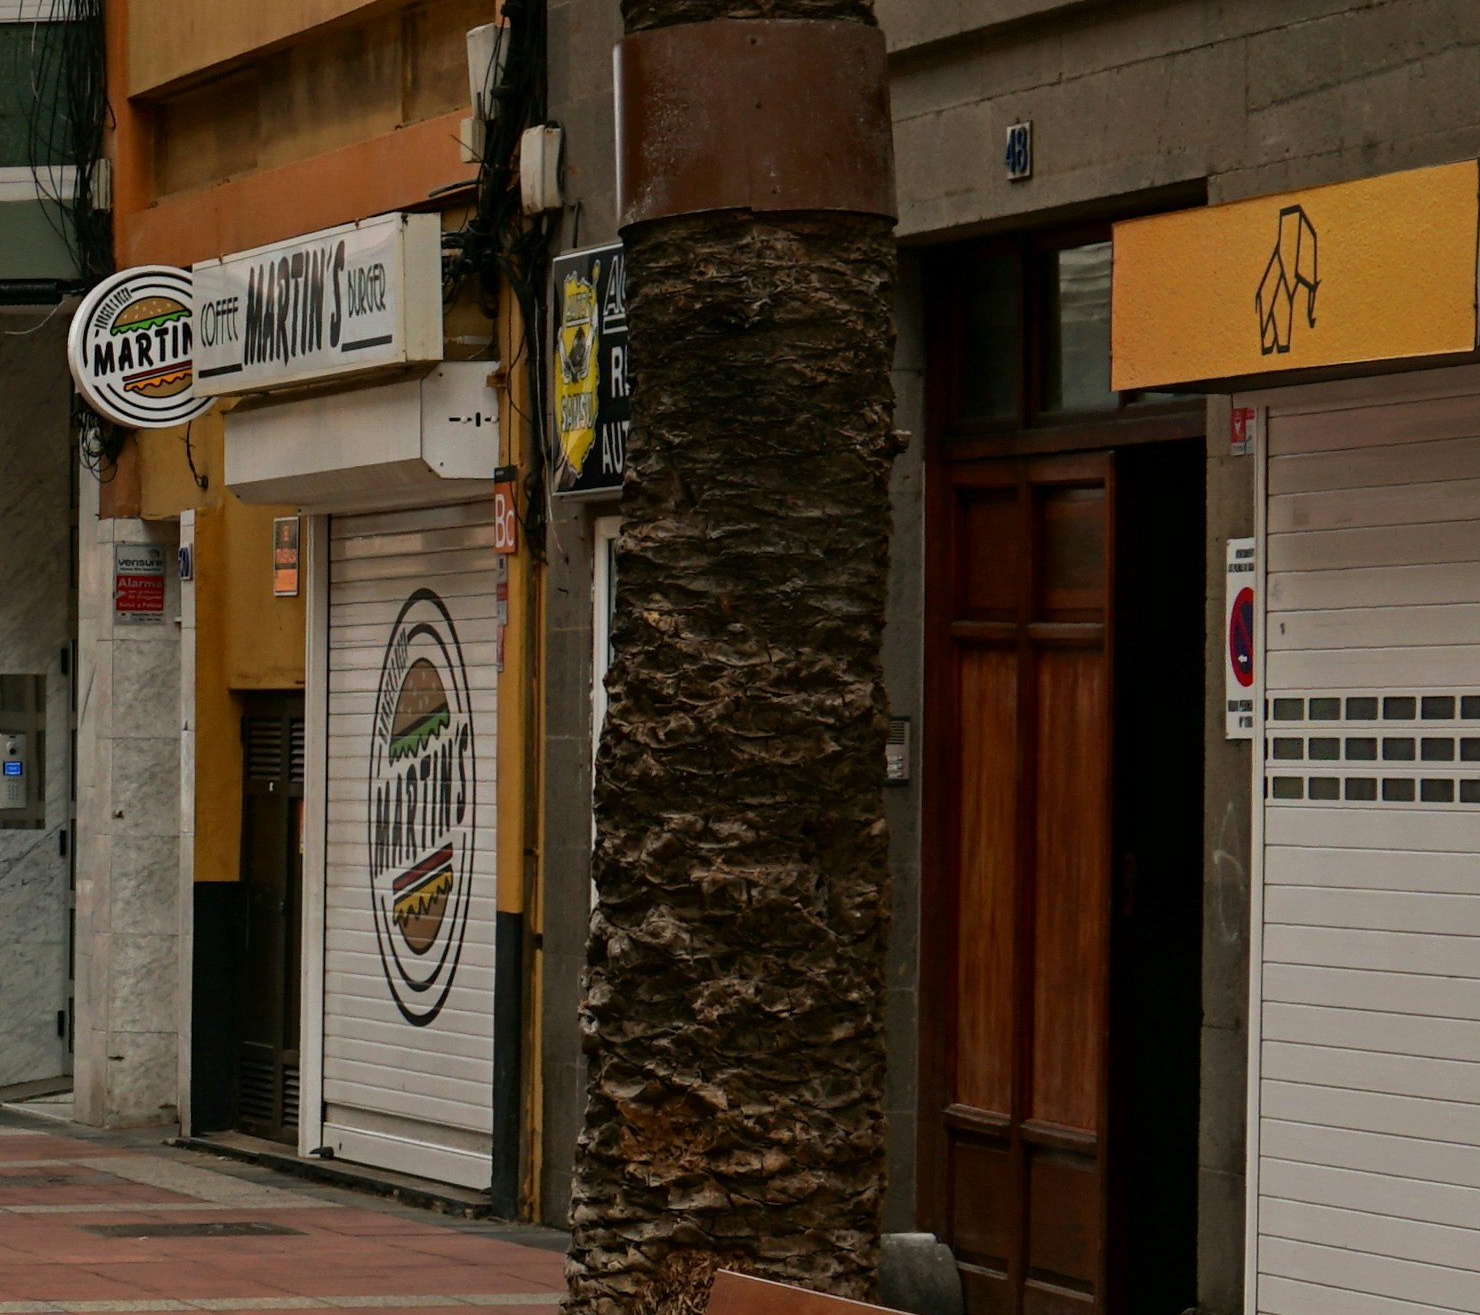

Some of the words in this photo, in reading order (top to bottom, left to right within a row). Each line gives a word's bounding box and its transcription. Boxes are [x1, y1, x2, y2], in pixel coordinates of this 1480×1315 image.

[1005, 127, 1028, 176] 48
[244, 240, 345, 367] MARTIN'S
[347, 263, 387, 318] BURGER
[119, 578, 163, 588] Alarma
